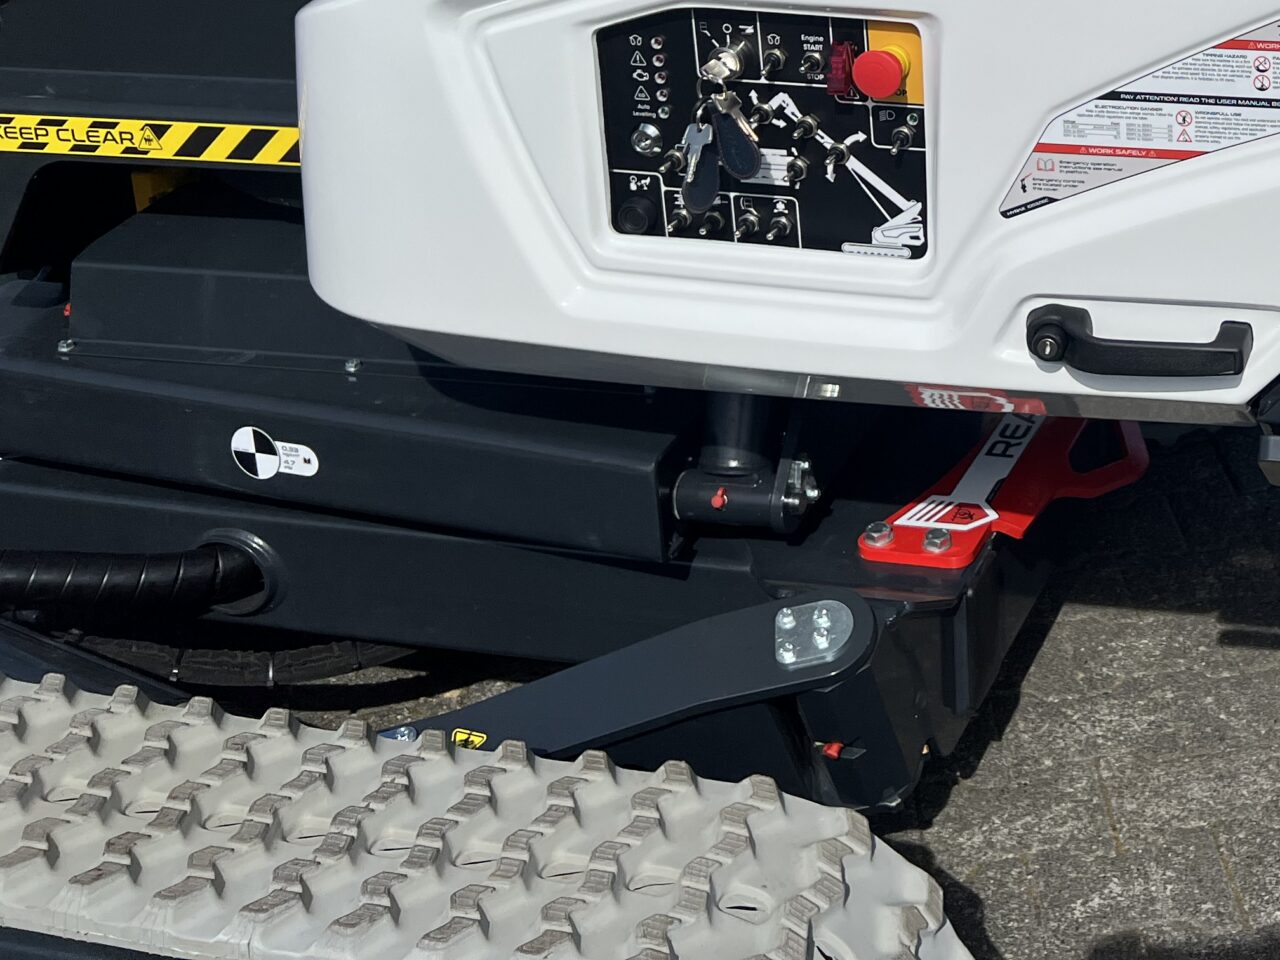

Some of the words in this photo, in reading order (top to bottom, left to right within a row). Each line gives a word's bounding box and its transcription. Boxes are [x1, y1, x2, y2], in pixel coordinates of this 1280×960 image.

[801, 34, 824, 43] Engine
[803, 43, 823, 51] START
[1135, 94, 1178, 102] ATTENTION!
[56, 128, 137, 146] CLEAR
[1088, 147, 1114, 155] WORK
[1115, 148, 1147, 157] SAFELY
